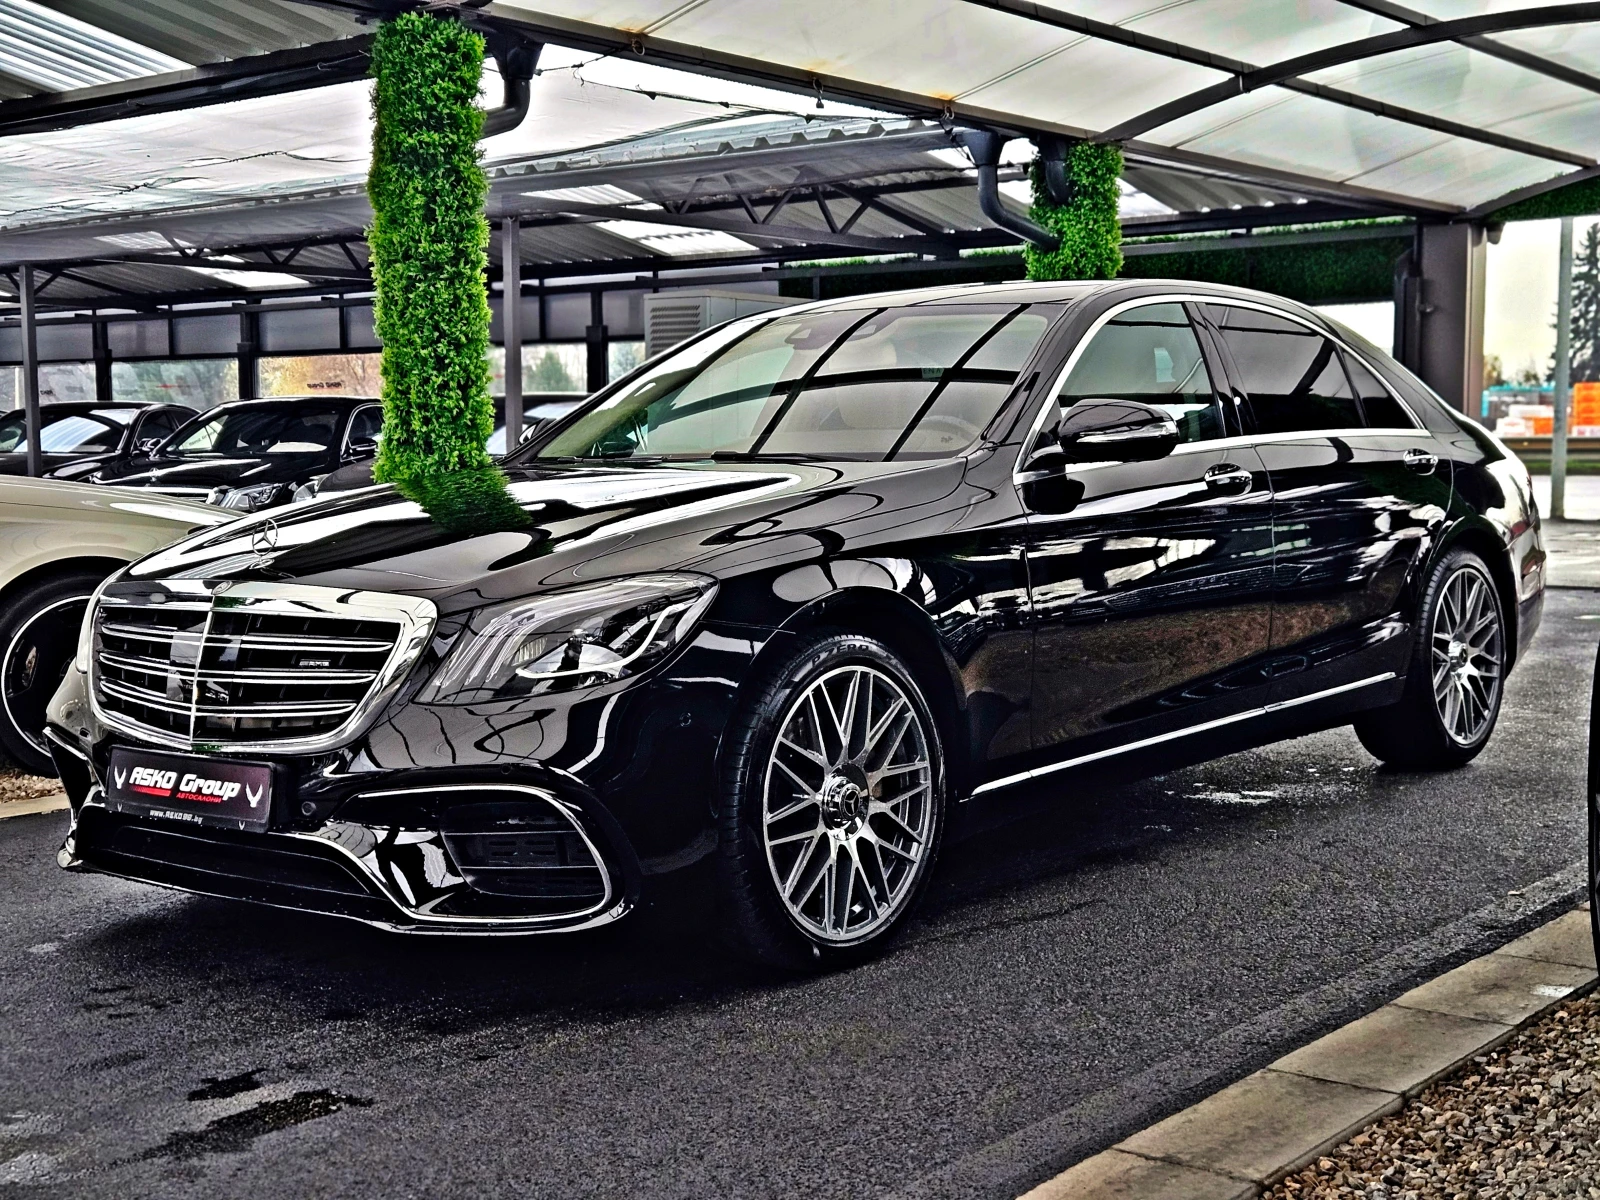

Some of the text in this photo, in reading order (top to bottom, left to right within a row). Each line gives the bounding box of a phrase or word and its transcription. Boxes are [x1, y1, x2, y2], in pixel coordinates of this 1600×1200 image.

[811, 654, 821, 668] P
[128, 766, 241, 801] ASKO Group
[175, 792, 222, 803] АВТОСАЛОНИ
